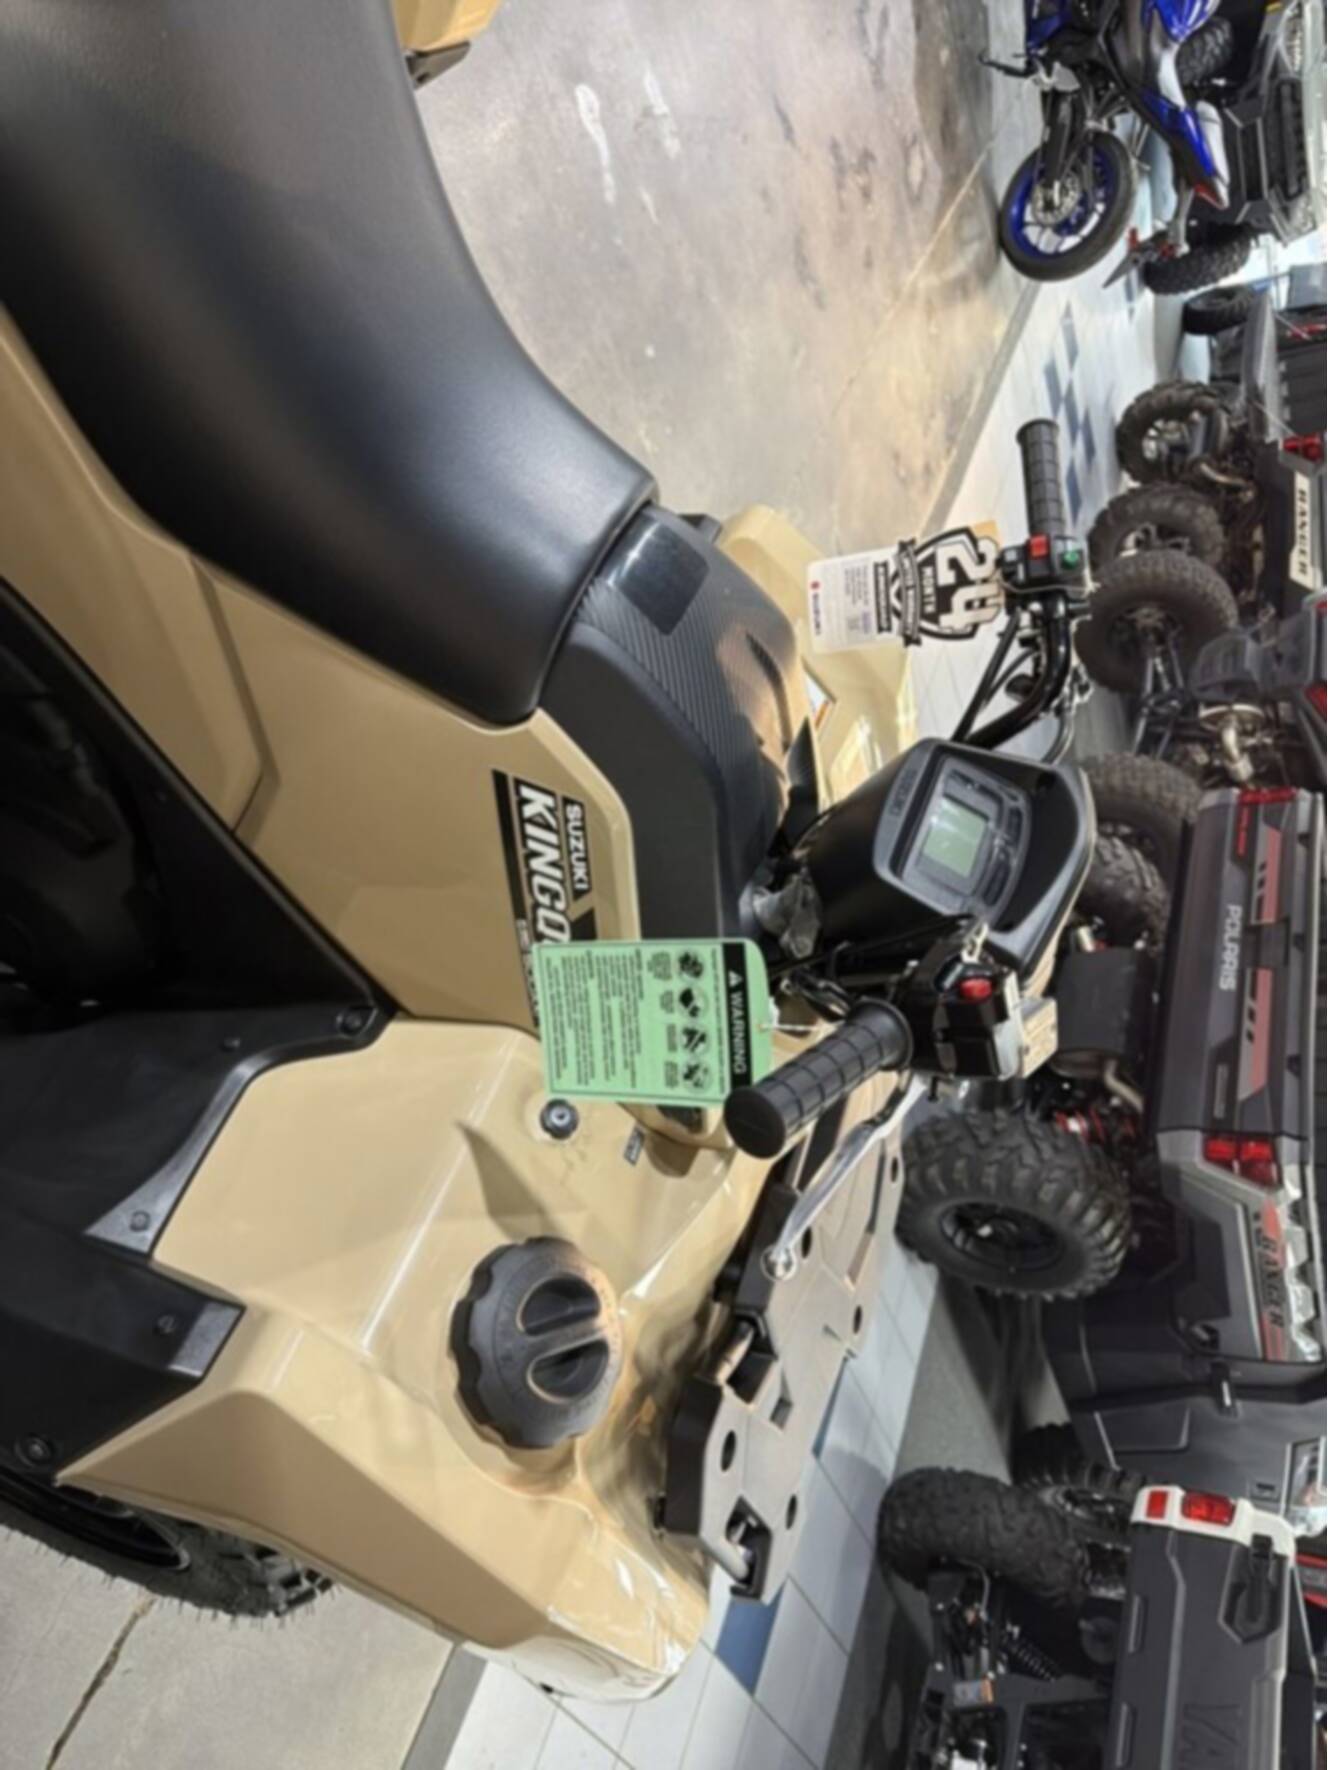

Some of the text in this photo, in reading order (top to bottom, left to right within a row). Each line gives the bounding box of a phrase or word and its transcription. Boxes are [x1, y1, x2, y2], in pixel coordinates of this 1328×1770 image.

[1297, 488, 1309, 576] RANGER
[922, 566, 936, 615] MONTH
[937, 537, 1003, 628] 24
[519, 784, 572, 943] KINGQ
[566, 804, 588, 889] SUZUKI
[1219, 904, 1243, 991] POLARIS
[730, 991, 747, 1074] WARNING
[1260, 1235, 1286, 1328] RANGER
[1181, 1702, 1242, 1770] YA
